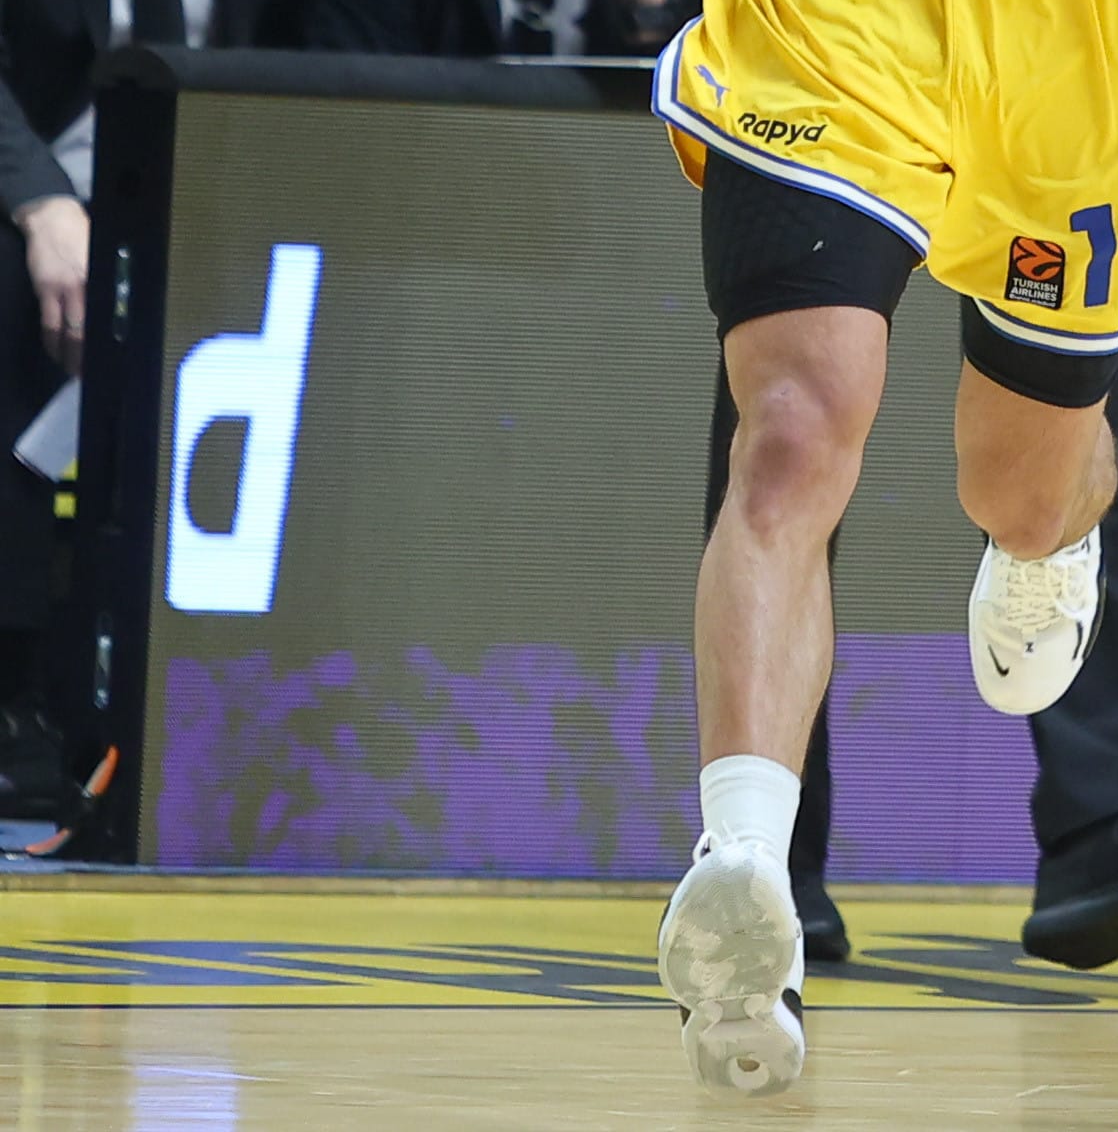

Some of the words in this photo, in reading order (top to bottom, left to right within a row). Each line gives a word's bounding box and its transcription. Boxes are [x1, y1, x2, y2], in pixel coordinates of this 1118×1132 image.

[738, 112, 828, 146] Rapyd
[1010, 286, 1058, 302] AIRLINES
[1013, 277, 1059, 294] TURKISH
